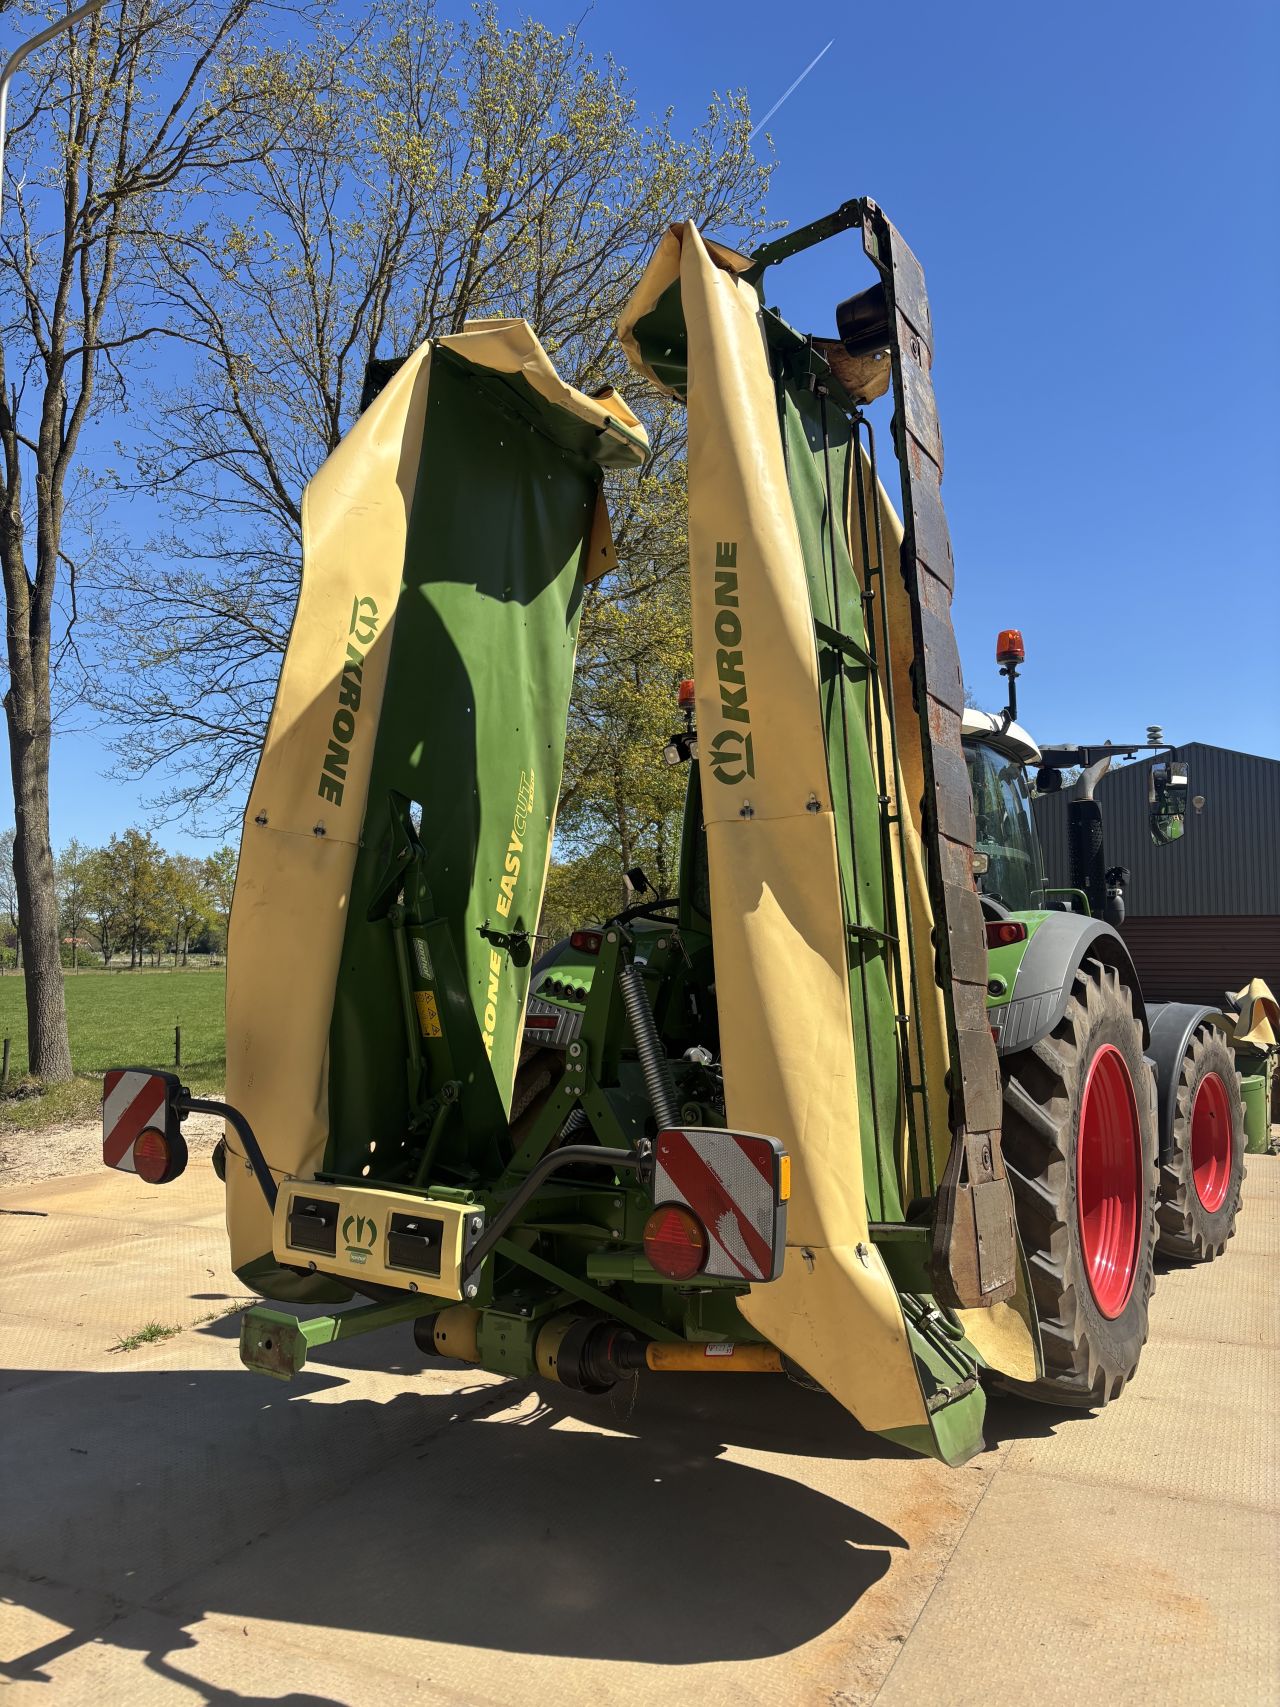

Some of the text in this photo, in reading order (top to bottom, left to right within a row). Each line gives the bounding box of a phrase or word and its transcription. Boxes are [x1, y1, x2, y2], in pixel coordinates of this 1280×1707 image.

[714, 541, 751, 724] KRONE
[318, 643, 365, 808] KRONE
[482, 948, 503, 1062] RONE
